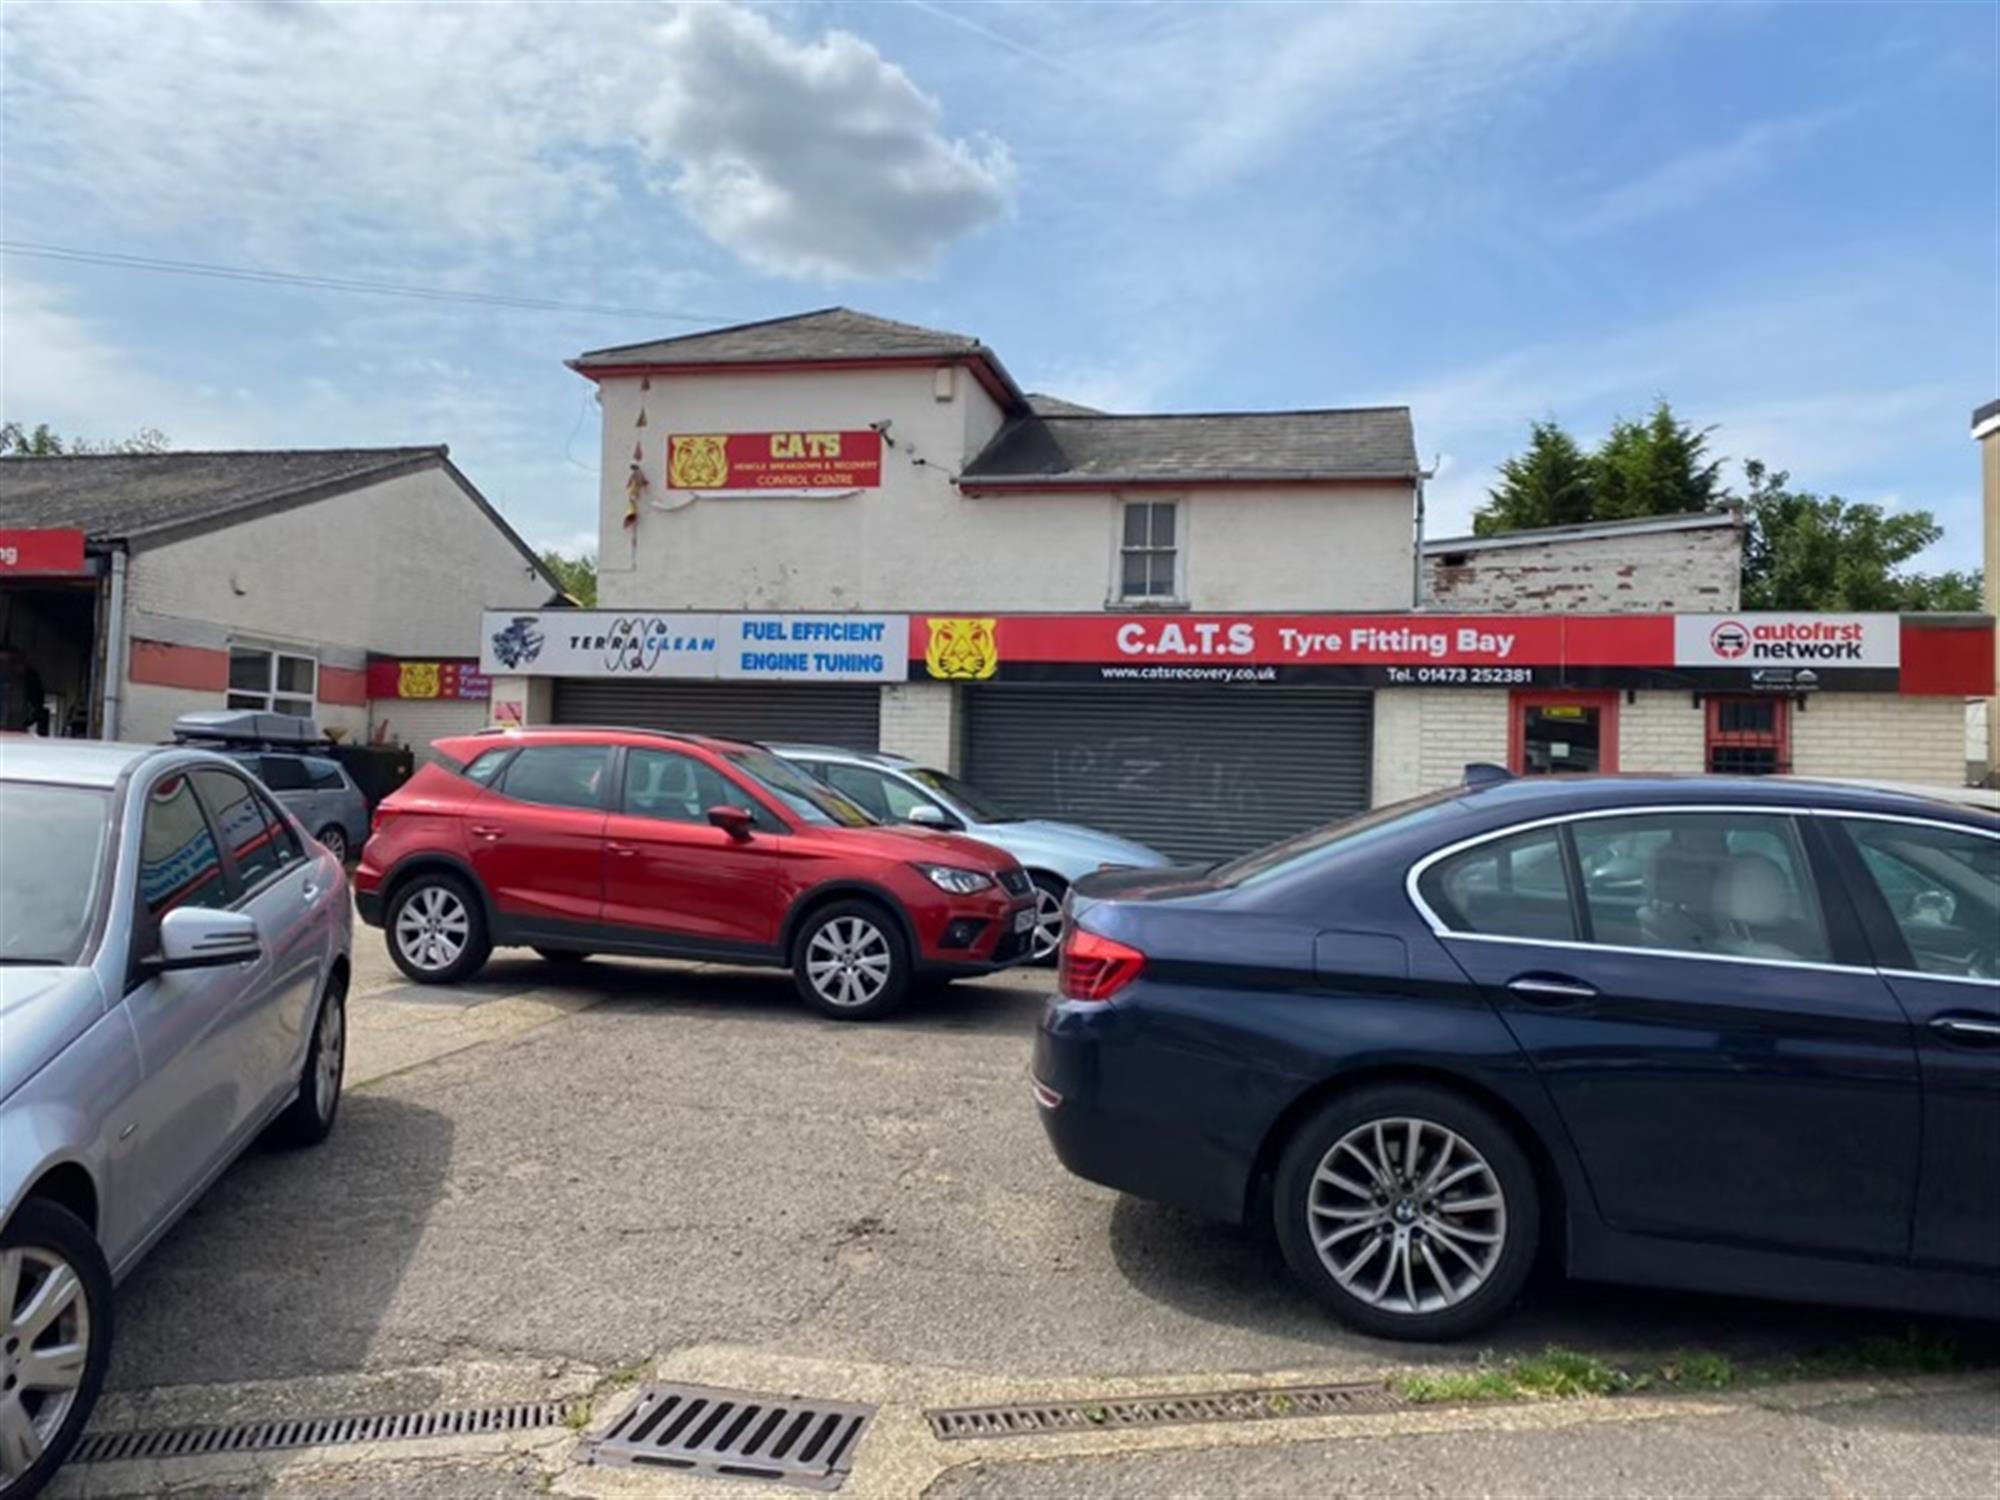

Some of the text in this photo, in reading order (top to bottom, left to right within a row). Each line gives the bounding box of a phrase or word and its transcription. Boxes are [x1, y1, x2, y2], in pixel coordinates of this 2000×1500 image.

[771, 433, 840, 458] CATS
[834, 460, 878, 470] RECOVERY
[757, 474, 853, 486] CONTROL CENTRE
[742, 621, 885, 641] FUEL EFFICIENT
[1116, 623, 1515, 657] C.A.T.S Tyre Fitting Bay
[1753, 622, 1863, 641] autofirst
[1753, 641, 1862, 659] network
[741, 653, 884, 673] ENGINE TUNING
[1101, 667, 1276, 682] www.catsrecovery.co.uk
[1387, 668, 1532, 682] Tel. 01473 252381
